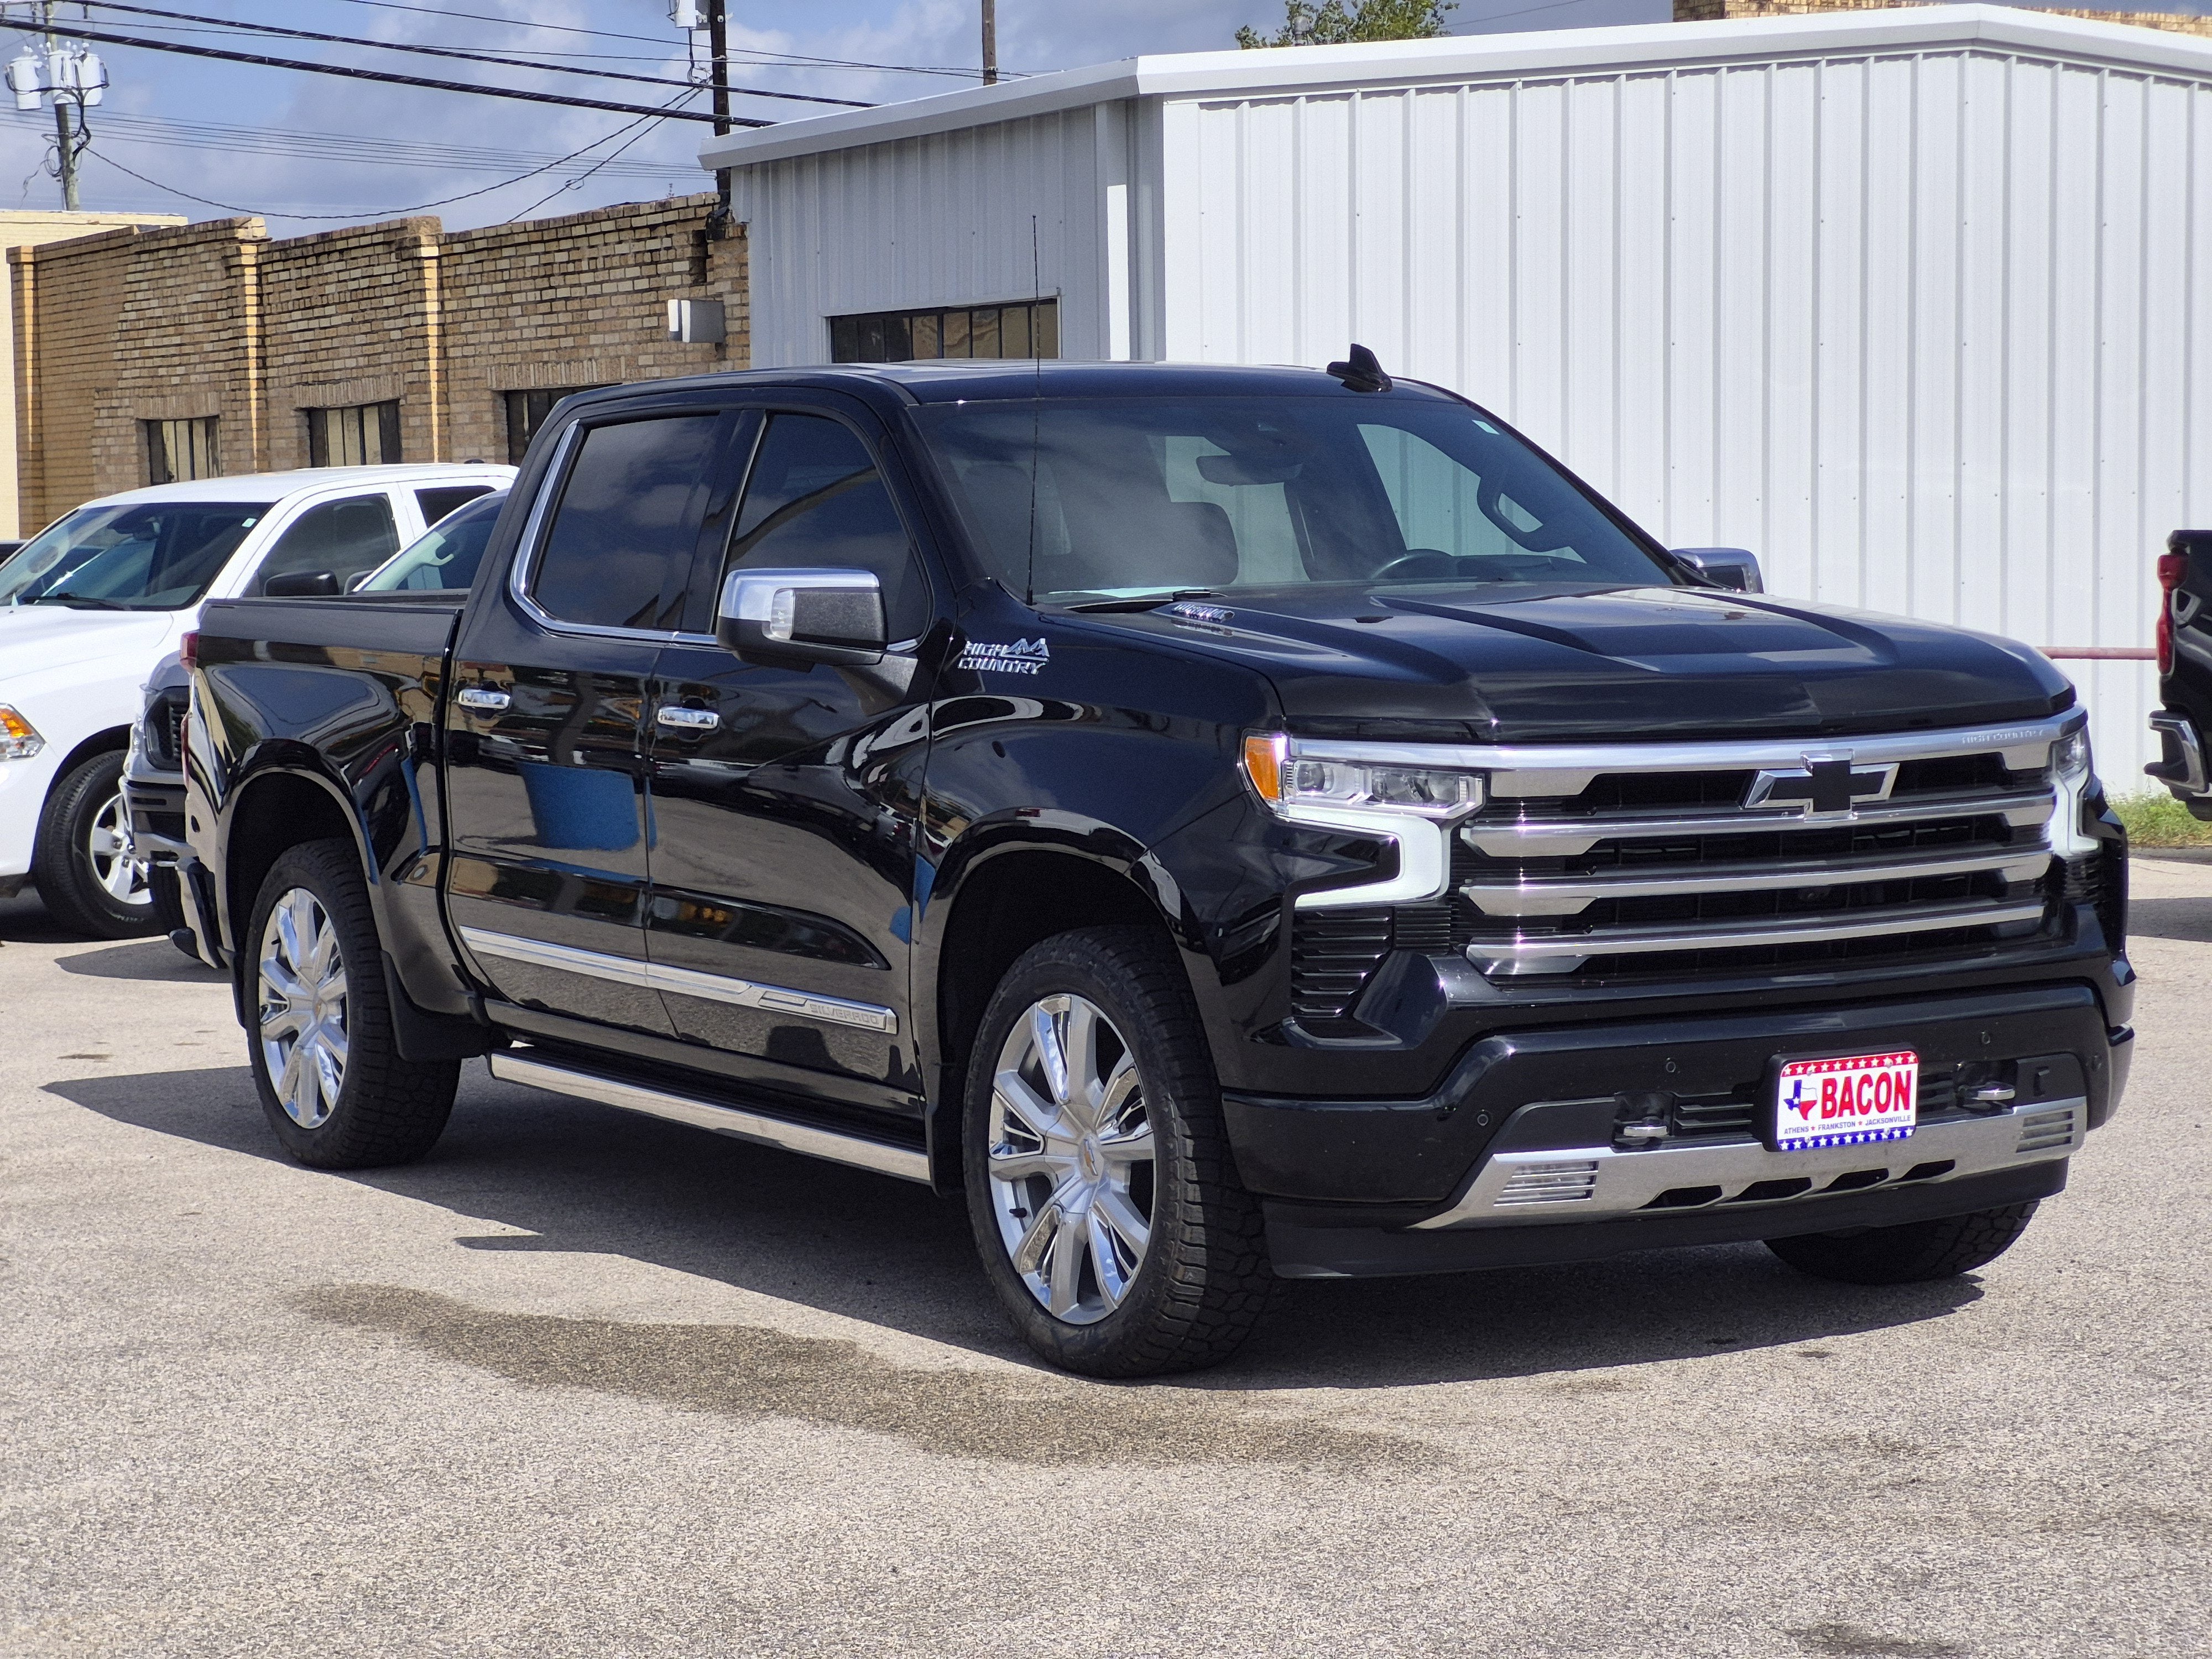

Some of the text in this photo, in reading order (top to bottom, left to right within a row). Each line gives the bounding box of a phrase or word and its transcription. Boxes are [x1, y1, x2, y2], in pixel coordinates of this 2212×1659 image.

[963, 641, 1009, 656] HIGH
[958, 657, 1046, 675] COUNTRY
[1962, 735, 1990, 744] HIGH
[810, 1004, 879, 1025] SILVERADO
[1821, 1070, 1912, 1119] BACON
[1784, 1115, 1911, 1134] ATHENS FRANKSTON JACKSONVILLE
